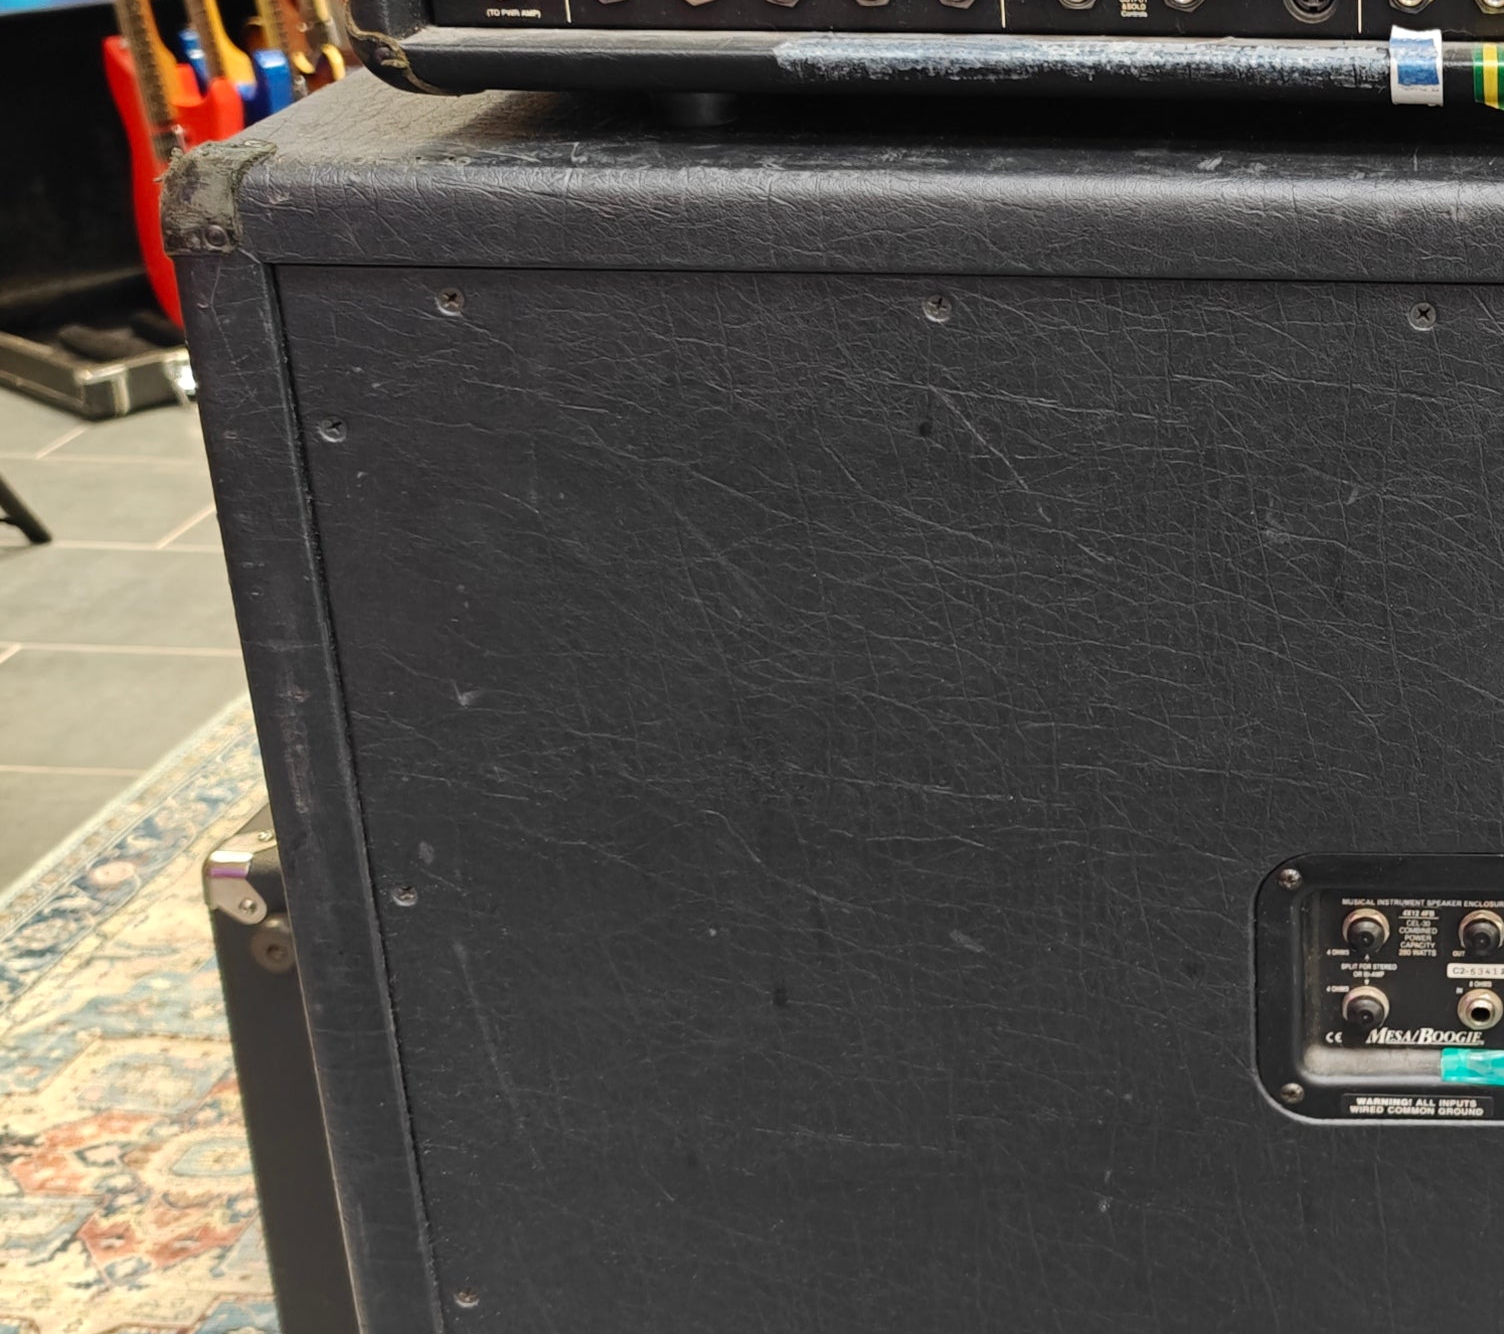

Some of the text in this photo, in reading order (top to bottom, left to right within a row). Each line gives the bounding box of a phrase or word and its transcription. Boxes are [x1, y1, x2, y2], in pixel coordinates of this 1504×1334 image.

[1342, 898, 1375, 906] MUSICAL
[1377, 899, 1425, 907] INSTRUMENT
[1426, 899, 1462, 908] SPEAKER
[1325, 1031, 1343, 1044] CE
[1365, 1026, 1485, 1046] MESA/BOOGIE
[1356, 1096, 1478, 1108] WARNING! ALL INPUTS
[1349, 1105, 1484, 1117] WIRED COMMON GROUND
